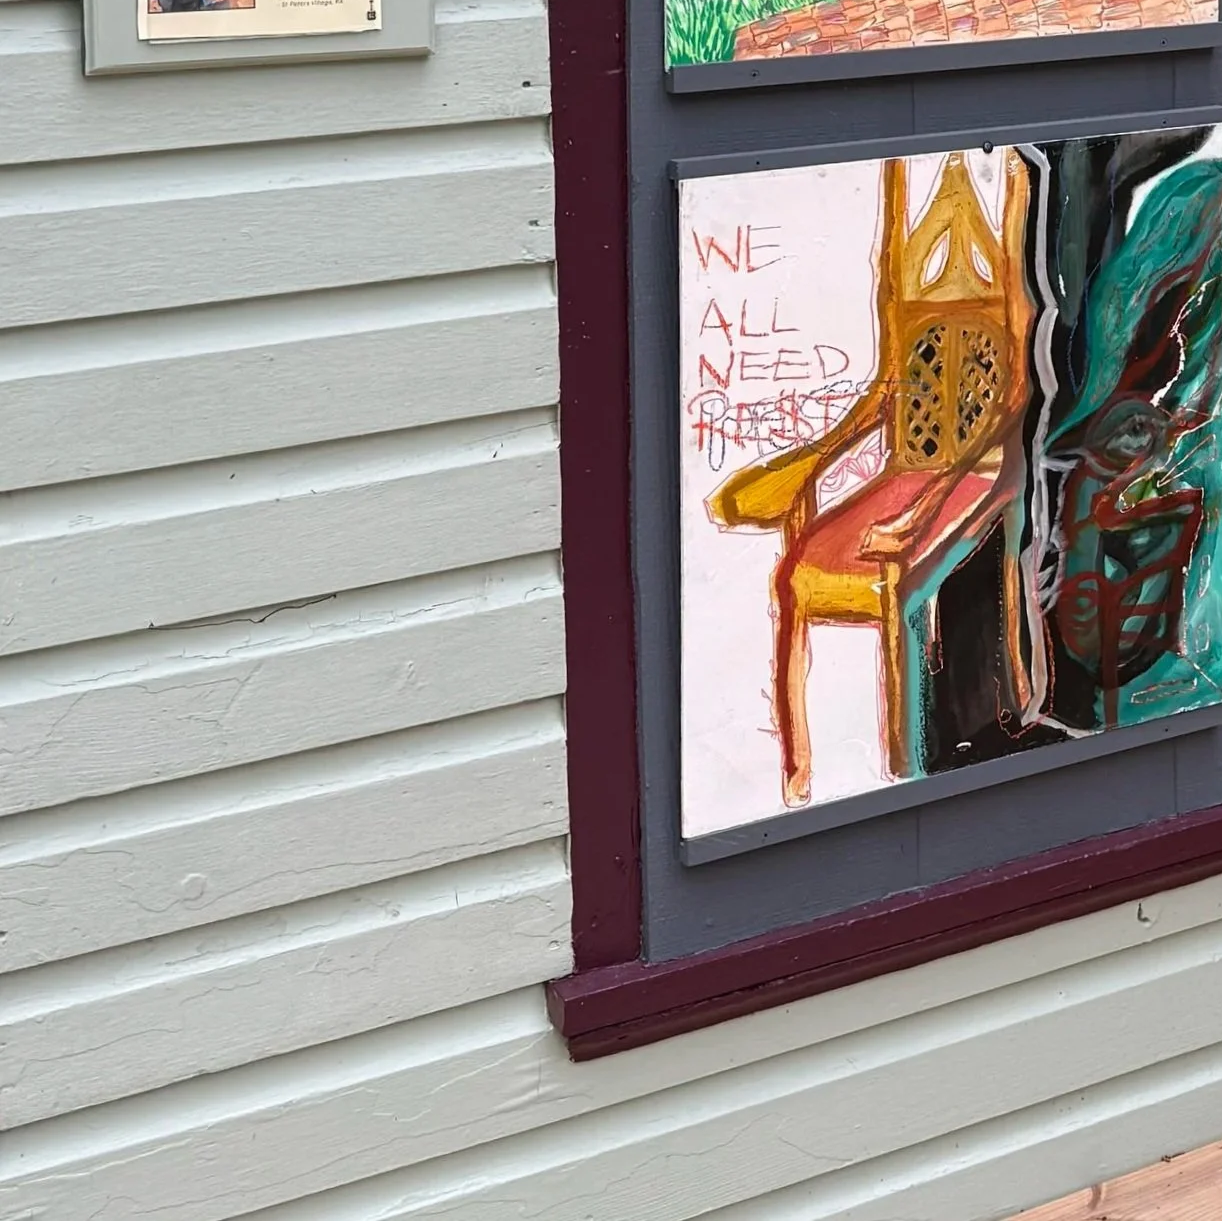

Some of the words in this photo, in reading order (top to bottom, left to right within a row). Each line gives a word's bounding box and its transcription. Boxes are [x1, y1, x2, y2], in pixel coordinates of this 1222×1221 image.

[691, 224, 792, 274] WE
[699, 297, 801, 347] ALL
[699, 343, 851, 390] NEED
